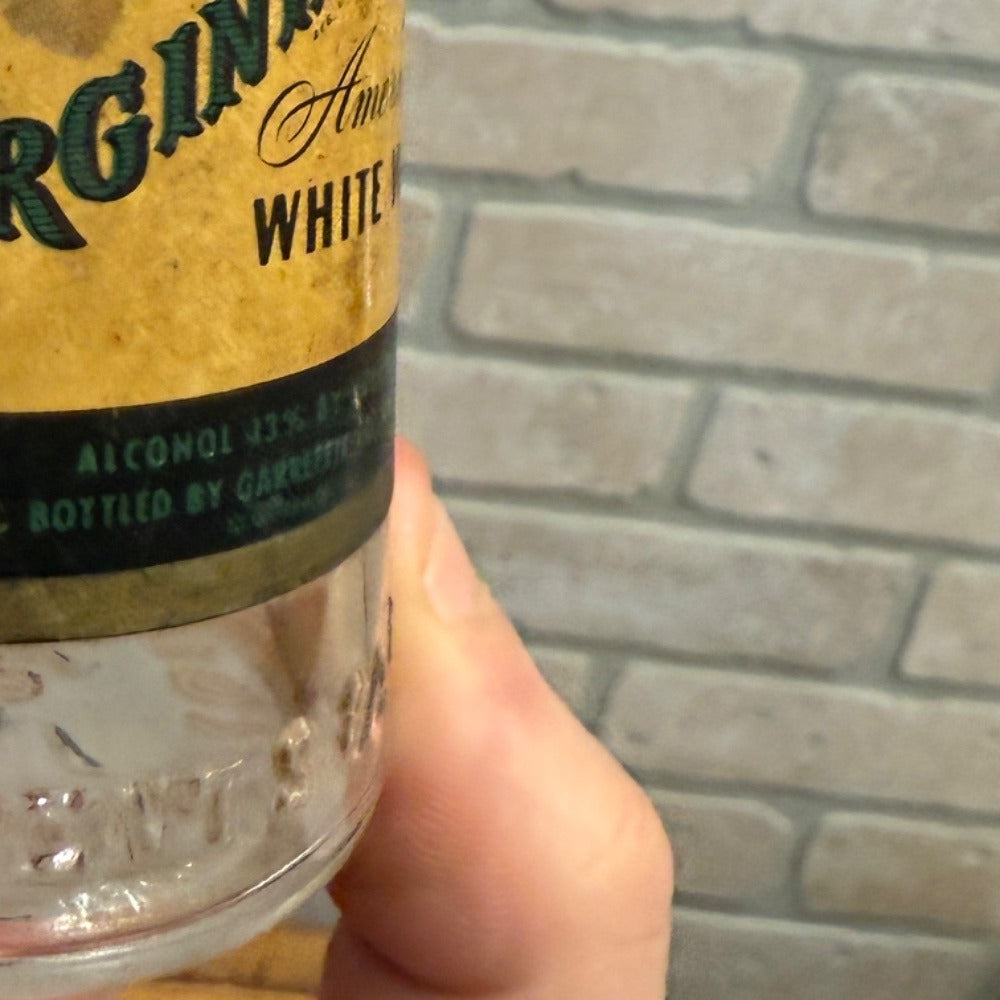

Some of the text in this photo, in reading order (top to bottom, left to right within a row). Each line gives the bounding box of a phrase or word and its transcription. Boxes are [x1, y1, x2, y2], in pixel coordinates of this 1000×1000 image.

[253, 160, 383, 266] WHITE
[76, 424, 232, 475] ALCOHOL
[29, 489, 172, 533] BOTTLED
[185, 480, 223, 515] BY
